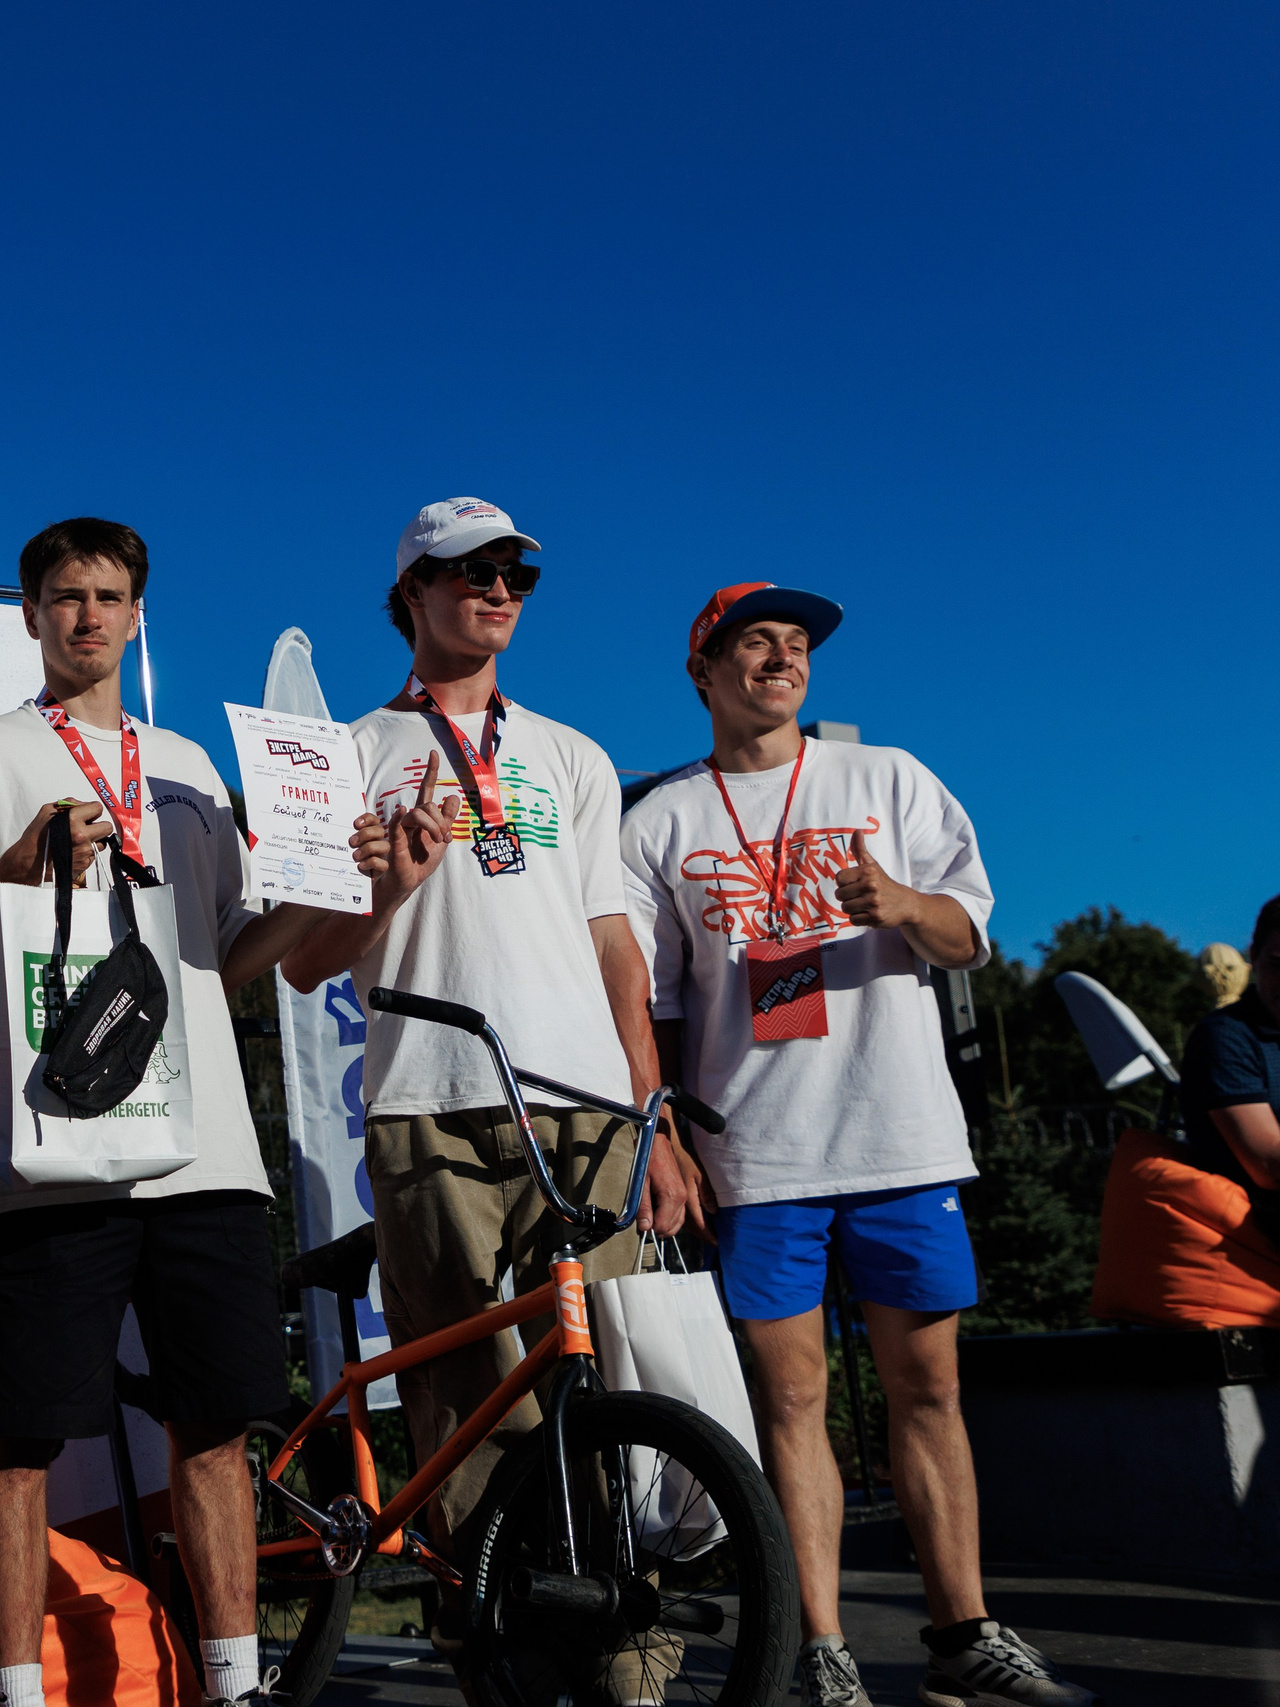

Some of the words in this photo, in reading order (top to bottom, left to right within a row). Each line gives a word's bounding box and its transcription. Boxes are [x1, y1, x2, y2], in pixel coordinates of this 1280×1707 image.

[268, 741, 301, 754] ЭКСТРЕ
[291, 750, 318, 763] МАЛЬ
[312, 757, 328, 769] НО
[281, 784, 330, 805] ГРАМОТА
[145, 794, 176, 813] CALLED
[175, 795, 183, 804] A
[182, 796, 211, 836] GARMENT
[303, 825, 309, 836] 2
[304, 845, 320, 856] PRO
[479, 838, 512, 852] ЭКСТРЕ
[489, 846, 515, 859] МАЛЬ
[498, 852, 514, 862] НО
[800, 966, 818, 985] НО
[781, 970, 803, 1001] МАЛЬ
[31, 986, 89, 1007] GRE
[757, 978, 787, 1013] ЭКСТРЕ
[85, 1015, 112, 1055] ЗДОРОВАЯ
[110, 991, 132, 1018] НАЦИЯ
[102, 1102, 170, 1118] NERGETIC
[476, 1508, 504, 1599] MIRAGE
